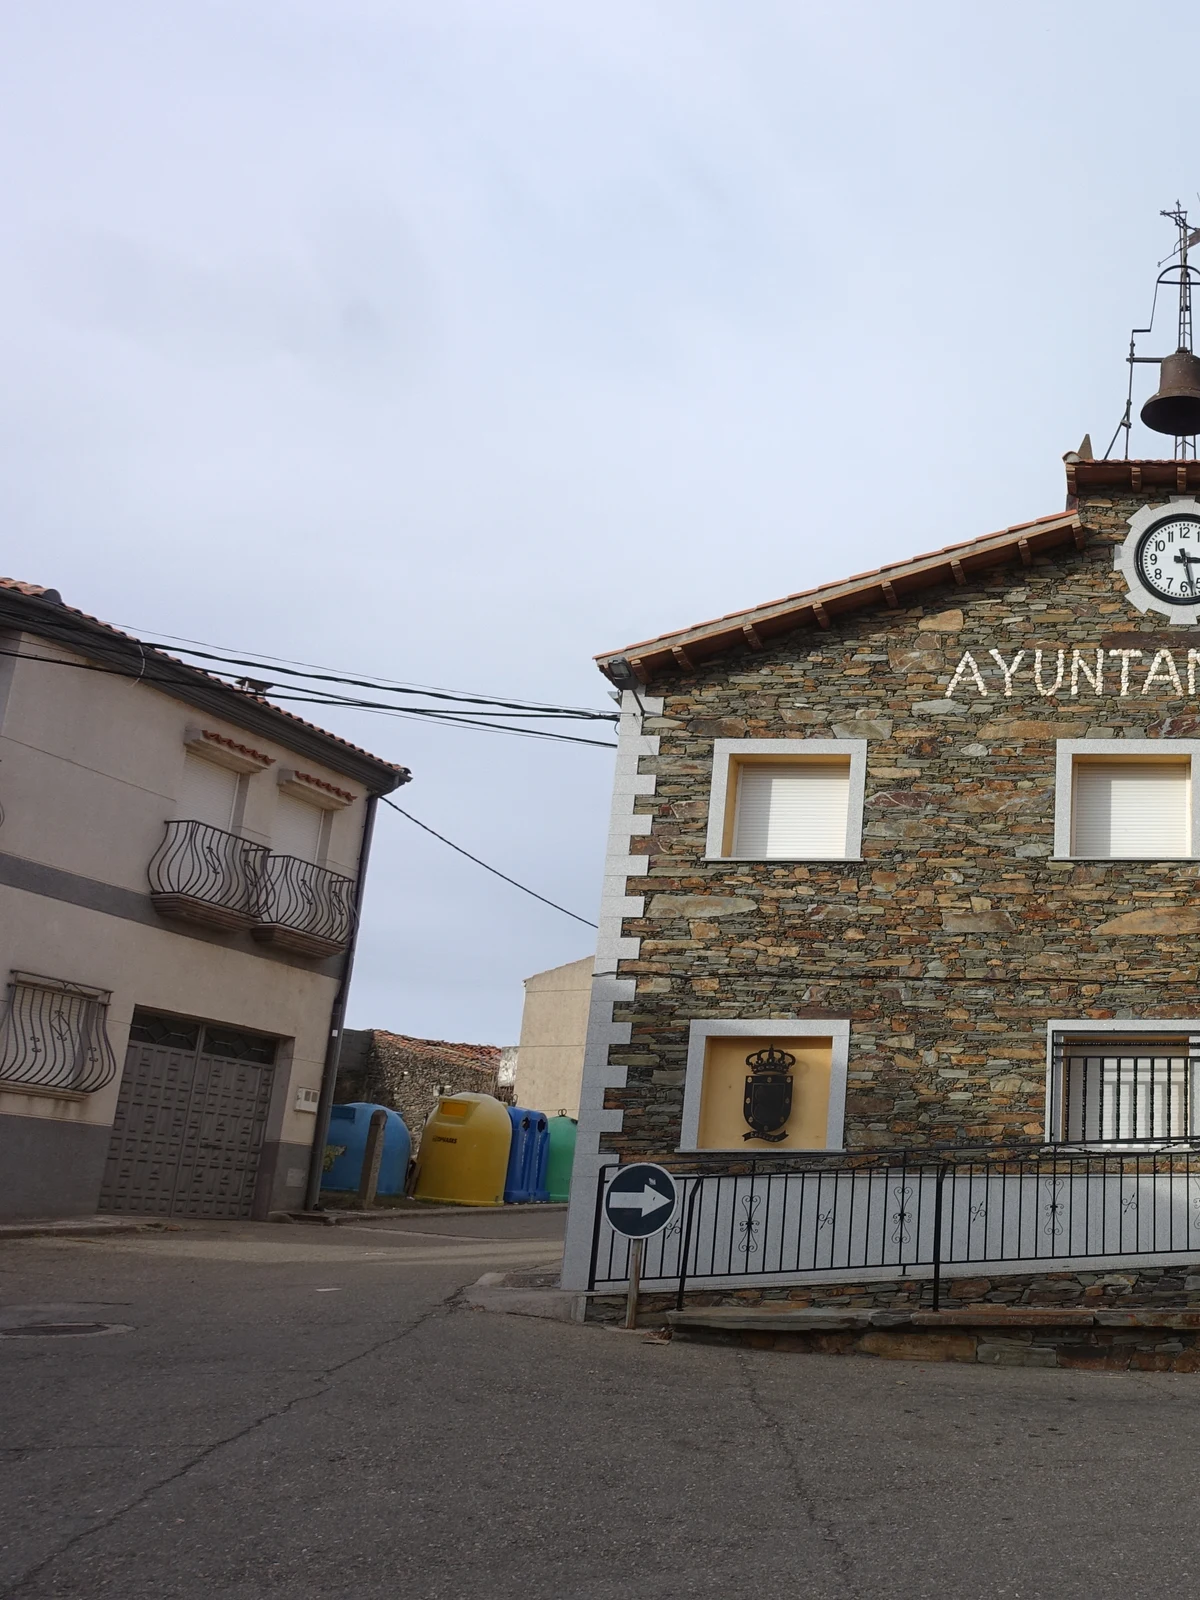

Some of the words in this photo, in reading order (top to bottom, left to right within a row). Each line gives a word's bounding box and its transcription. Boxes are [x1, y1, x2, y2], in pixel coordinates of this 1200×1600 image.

[1167, 530, 1174, 543] 11
[1179, 526, 1191, 539] 12
[1196, 530, 1200, 543] 1
[1154, 539, 1166, 552] 10
[1150, 553, 1158, 566] 9
[1154, 568, 1162, 580] 8
[1165, 577, 1174, 589] 7
[1179, 581, 1188, 593] 6
